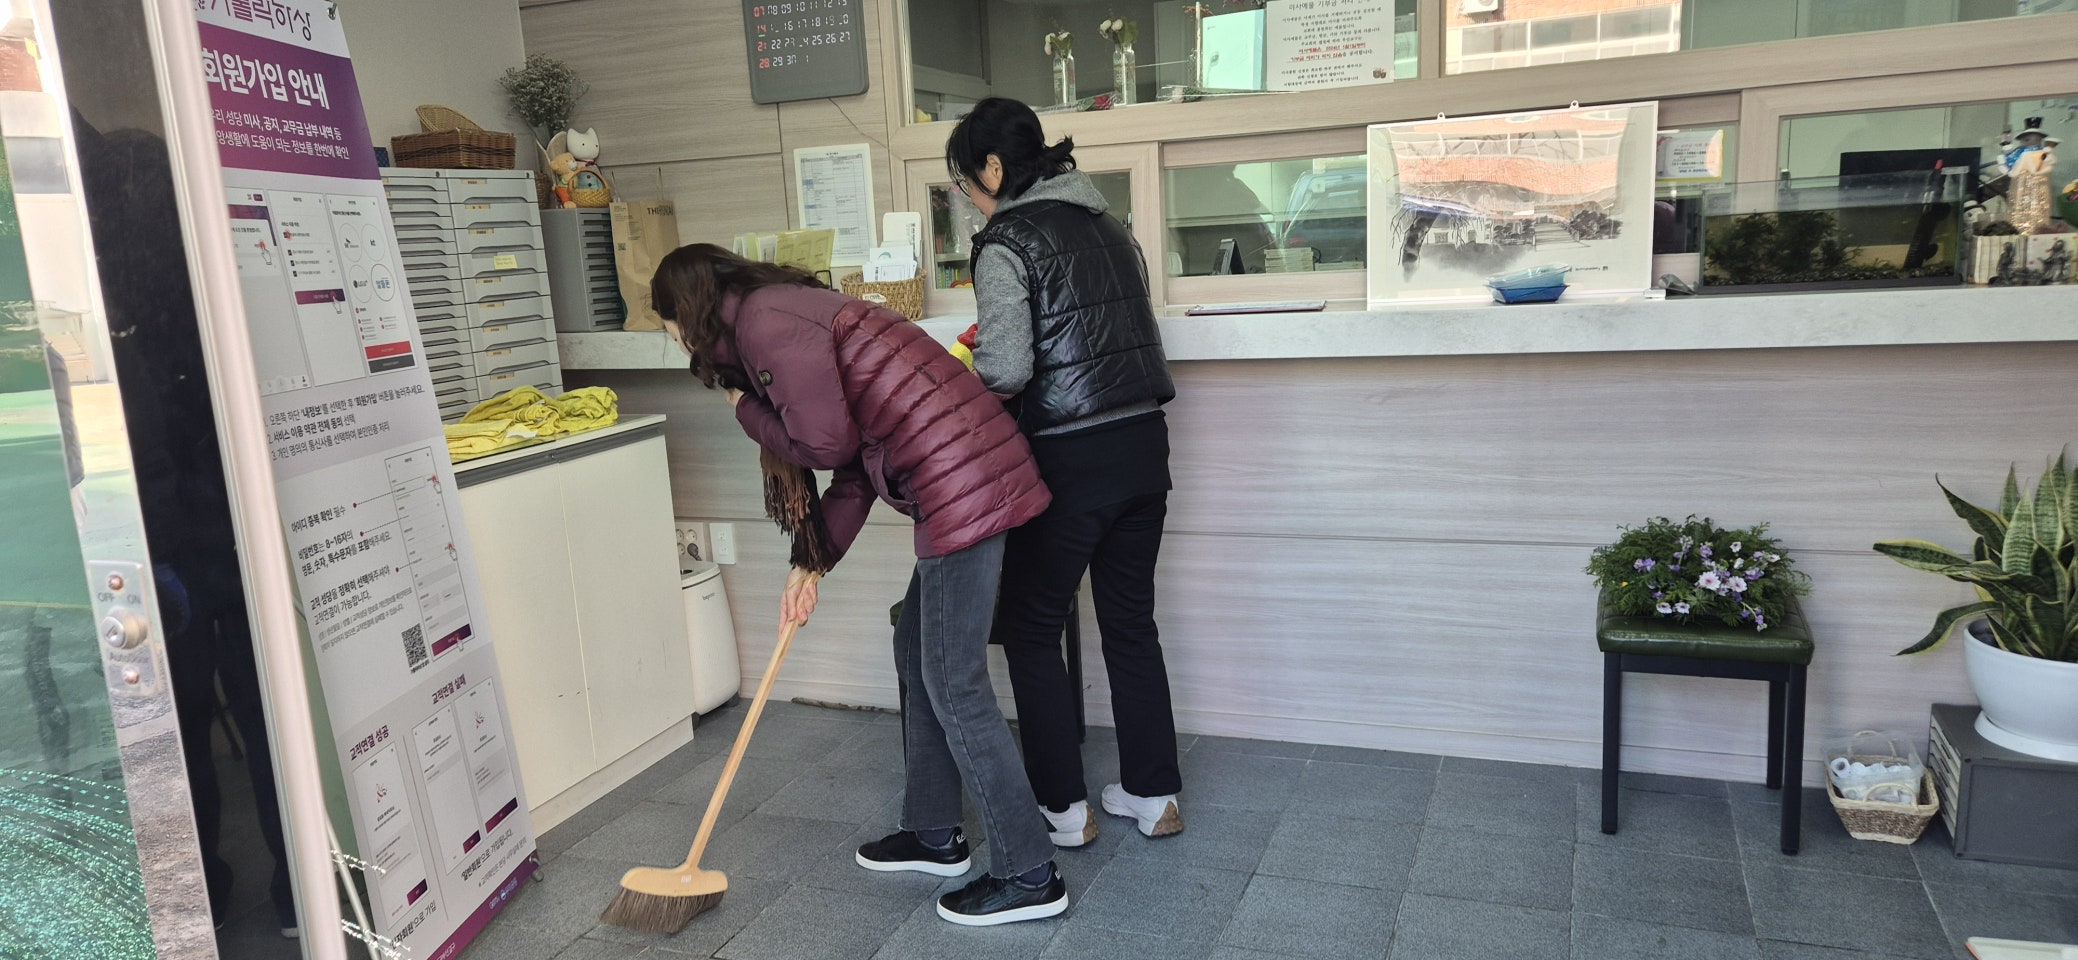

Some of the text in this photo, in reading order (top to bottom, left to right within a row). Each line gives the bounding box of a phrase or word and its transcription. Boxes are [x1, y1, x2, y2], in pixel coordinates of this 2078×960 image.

[754, 6, 765, 18] 07
[772, 40, 781, 50] 22
[812, 35, 822, 46] 25
[826, 34, 836, 44] 26
[288, 70, 330, 110] 안내
[226, 110, 242, 126] 성당
[244, 113, 264, 132] 미사,
[263, 116, 282, 134] 공지,
[282, 120, 304, 136] 교무금
[304, 122, 319, 138] 납부
[320, 124, 334, 140] 내역
[334, 128, 342, 140] 등
[216, 130, 350, 160] 앙생활에 도움이 되는 정보를 한번에 확인
[270, 412, 288, 426] 오른쪽
[288, 409, 300, 421] 하단
[330, 400, 347, 414] 선택한
[348, 398, 354, 408] 후
[274, 429, 290, 442] 서비스
[291, 426, 304, 438] 이용
[304, 422, 318, 435] 약관
[317, 419, 330, 432] 전체
[330, 416, 344, 429] 동의
[344, 414, 356, 426] 선택
[278, 447, 290, 458] 개인
[309, 436, 332, 452] 통신사를
[334, 428, 356, 445] 선택하여
[357, 424, 378, 438] 본인인증
[291, 518, 308, 533] 아이디
[308, 513, 320, 528] 중복
[320, 508, 334, 522] 확인
[314, 556, 328, 571] 숫자,
[328, 544, 358, 564] 특수문자를
[321, 588, 338, 605] 성당을
[338, 579, 357, 596] 정확히
[314, 604, 340, 626] 교적연결이
[432, 674, 467, 705] 교적연결 실패
[350, 724, 390, 761] 교적연결 성공
[425, 900, 436, 916] 가입
